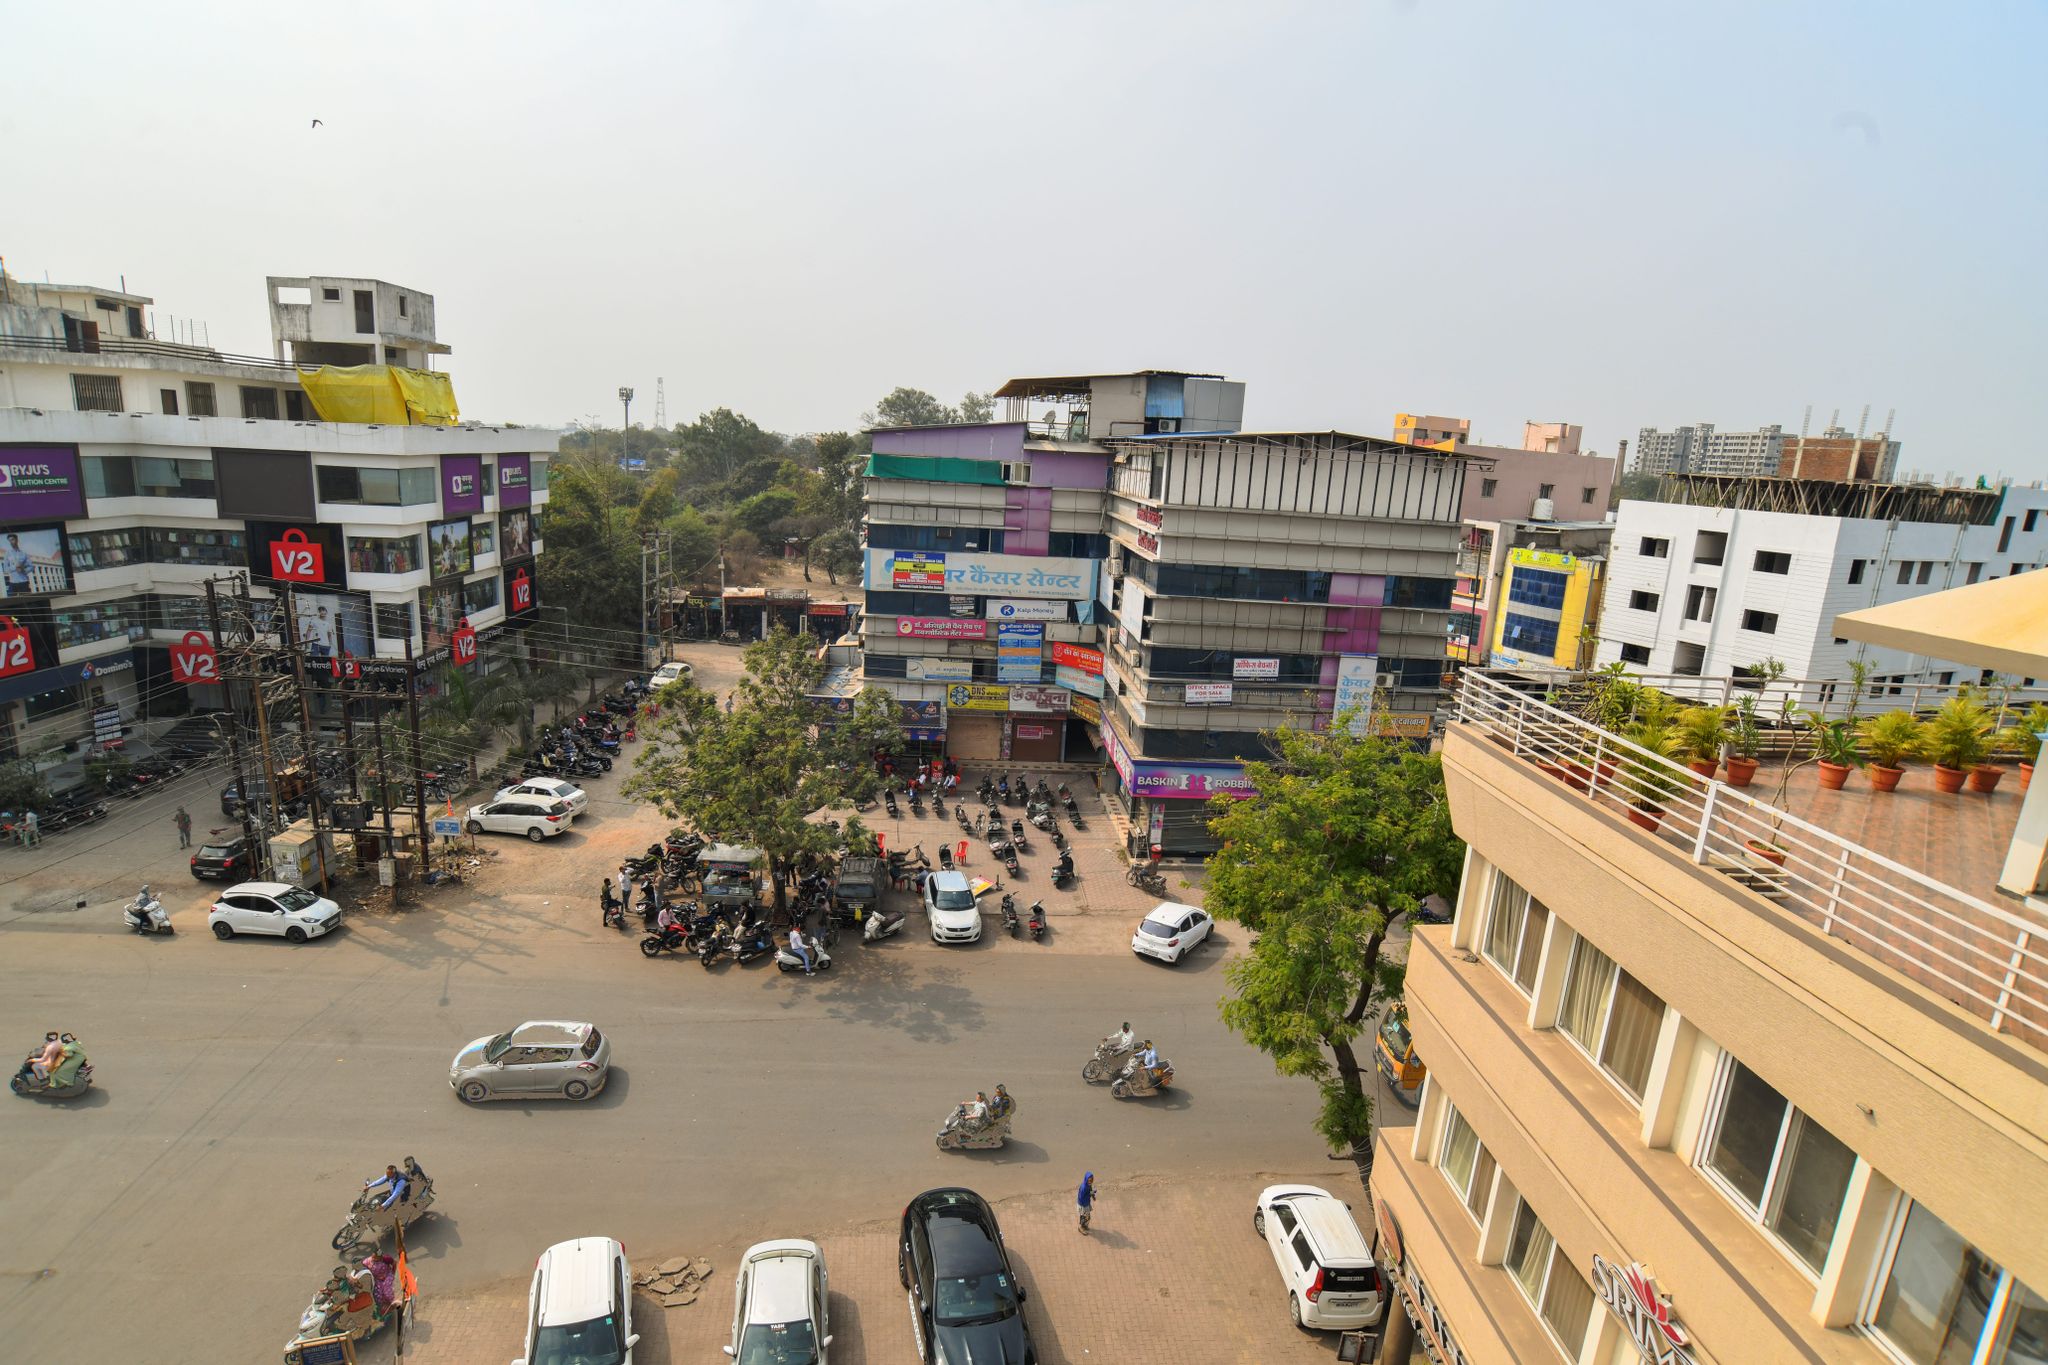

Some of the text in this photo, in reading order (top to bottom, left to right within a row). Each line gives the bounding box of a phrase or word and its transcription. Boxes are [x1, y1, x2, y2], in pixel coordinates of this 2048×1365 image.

[10, 464, 50, 476] BYJU'S
[277, 550, 314, 575] V2
[1026, 568, 1082, 589] सेन्टर
[517, 584, 530, 603] V2
[457, 635, 475, 659] V2
[95, 660, 134, 677] Domino's
[177, 653, 215, 677] V2
[1342, 675, 1371, 688] केयर
[1137, 776, 1178, 787] BASKIN
